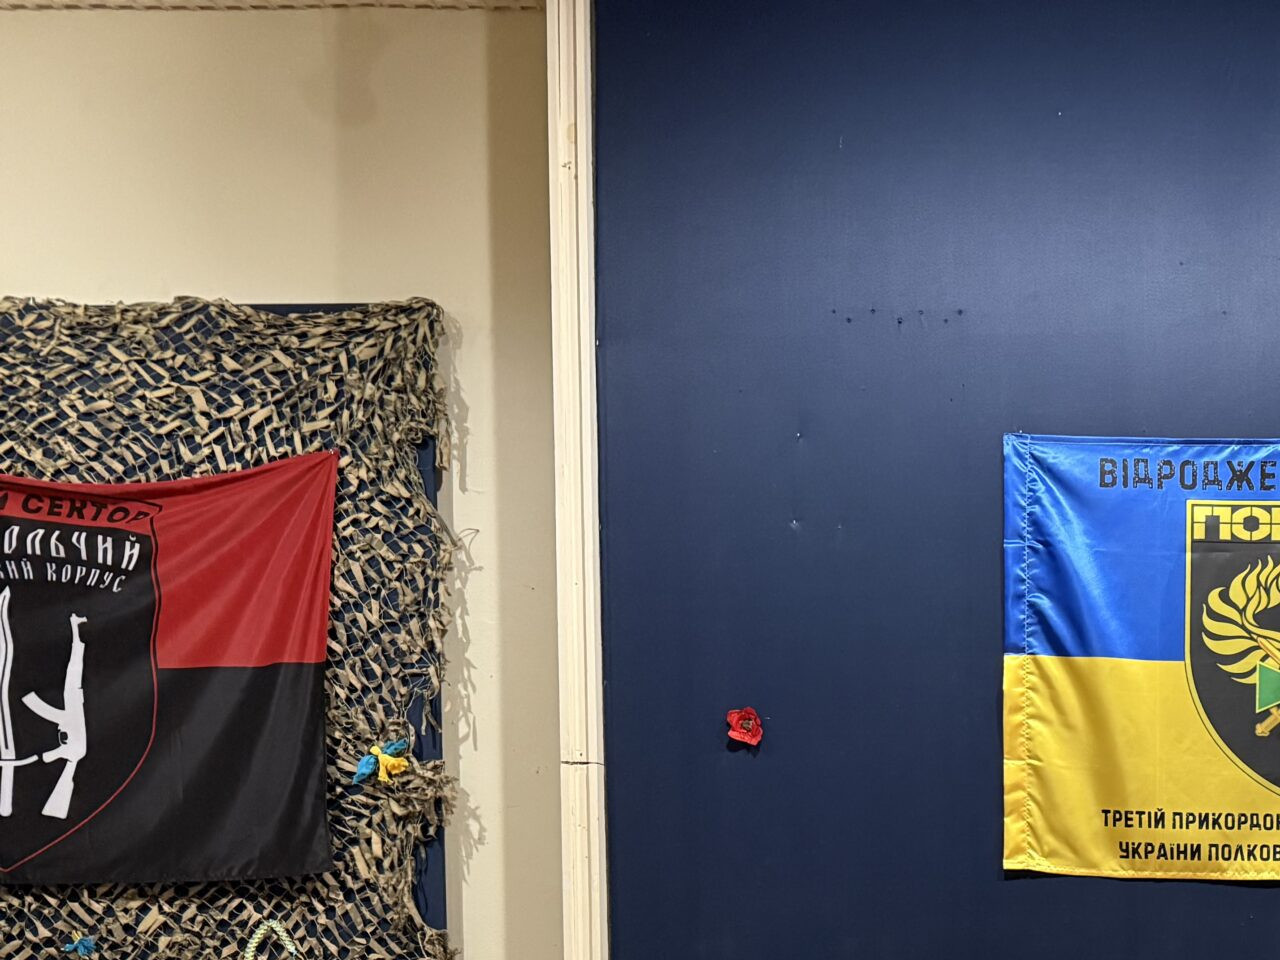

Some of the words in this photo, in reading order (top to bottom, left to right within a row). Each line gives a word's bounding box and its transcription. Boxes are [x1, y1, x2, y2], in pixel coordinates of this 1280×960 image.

[21, 493, 150, 524] СЕКТОР
[46, 562, 126, 593] КОРПУС
[1101, 808, 1166, 829] ТРЕТІЙ
[1119, 841, 1201, 861] УКРАЇНИ
